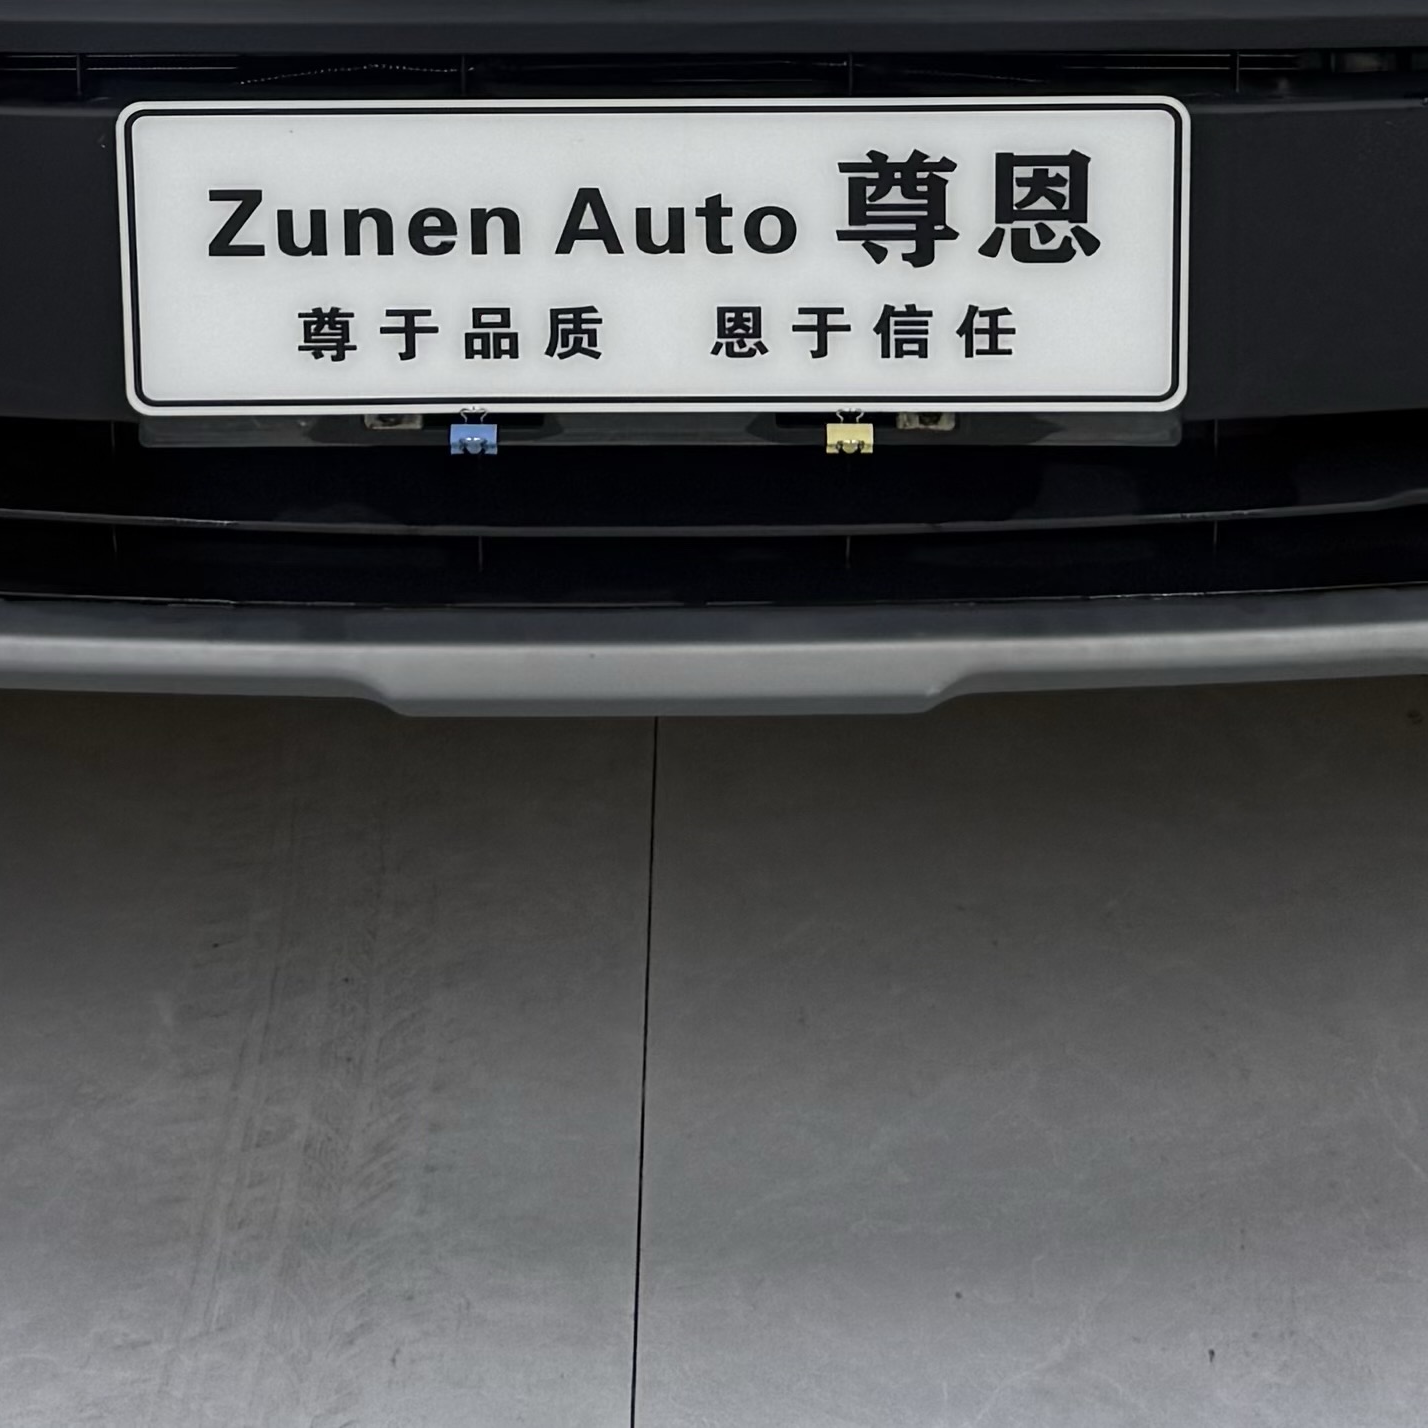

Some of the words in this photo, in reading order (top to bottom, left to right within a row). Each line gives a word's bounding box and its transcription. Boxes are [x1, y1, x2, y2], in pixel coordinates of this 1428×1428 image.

[208, 189, 521, 257] Zunen
[555, 187, 797, 255] Auto
[836, 149, 1101, 268] 尊恩
[298, 305, 603, 363] 尊于品质
[711, 303, 1016, 359] 恩于信任
